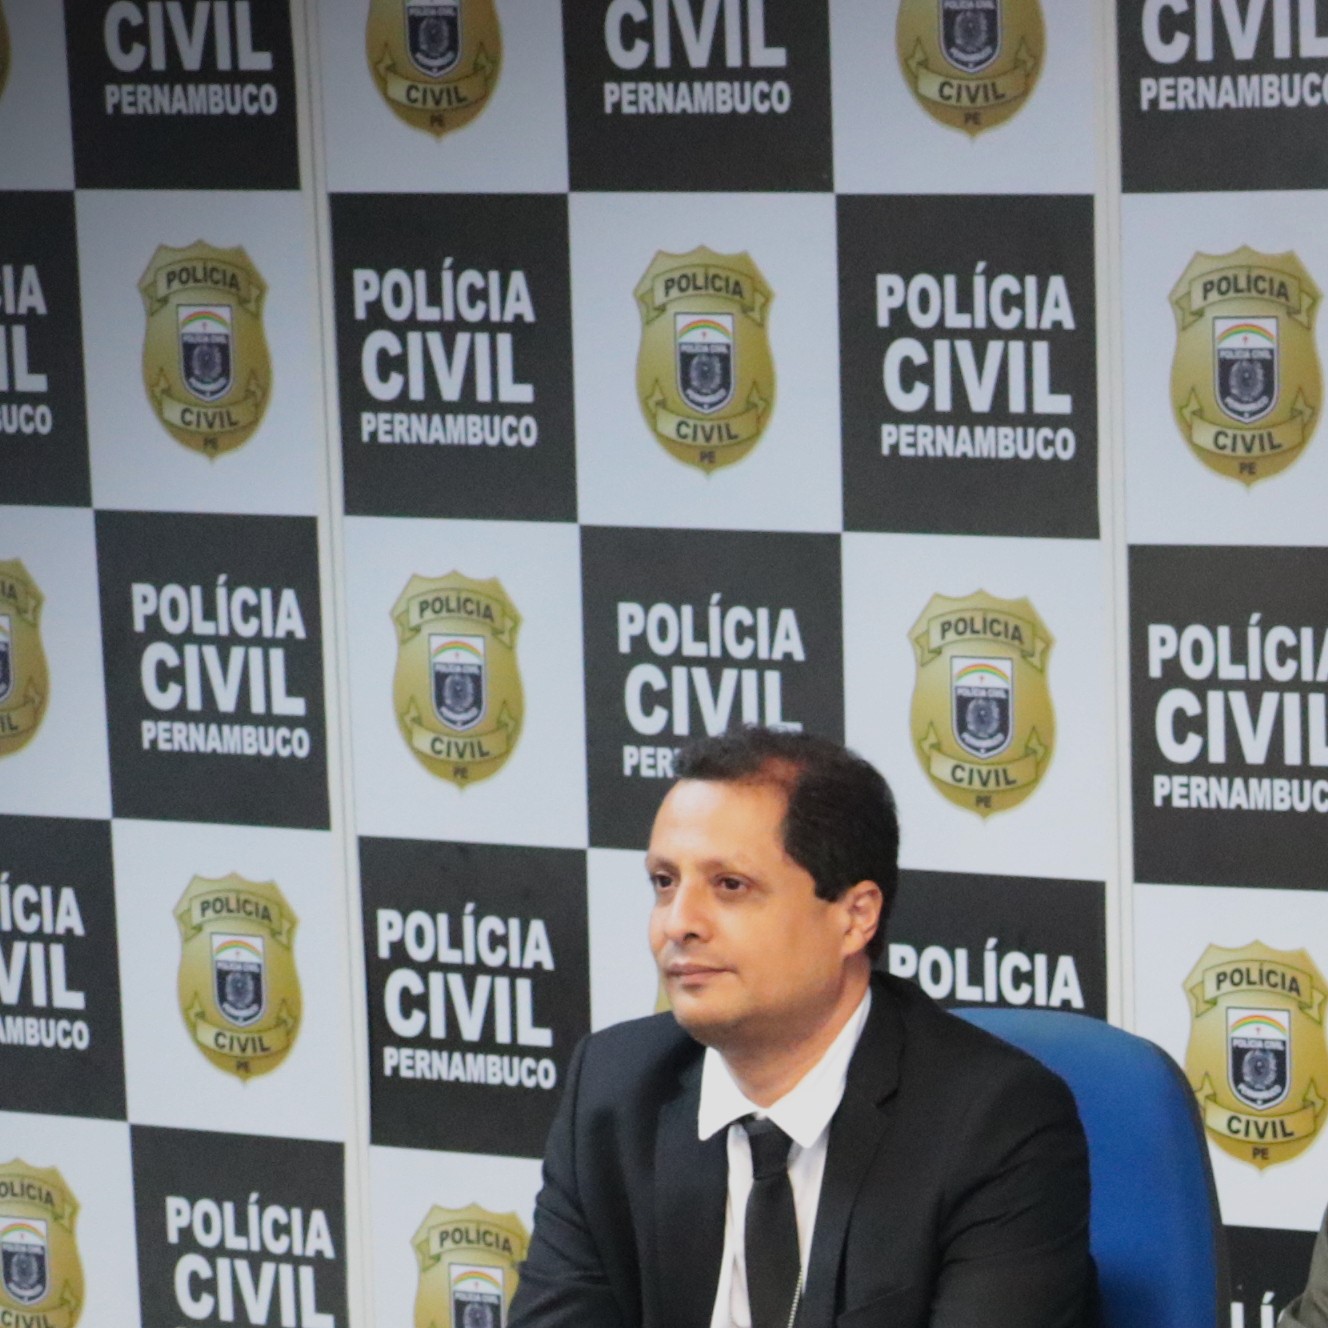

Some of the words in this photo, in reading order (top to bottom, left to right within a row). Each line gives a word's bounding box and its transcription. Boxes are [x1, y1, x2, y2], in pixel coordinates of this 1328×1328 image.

[105, 1, 273, 72] CIVIL
[605, 0, 786, 69] CIVIL
[105, 84, 277, 115] PERNAMBUCO
[406, 83, 468, 104] CIVIL
[604, 81, 791, 113] PERNAMBUCO
[938, 77, 1005, 105] CIVIL
[964, 111, 981, 125] PE
[166, 262, 240, 291] POLÍCIA
[353, 257, 535, 322] POLÍCIA
[664, 272, 744, 299] POLÍCIA
[1202, 273, 1289, 302] POLÍCIA
[876, 262, 1075, 329] POLÍCIA
[362, 330, 534, 403] CIVIL
[883, 338, 1072, 414] CIVIL
[180, 405, 239, 430] CIVIL
[361, 412, 537, 447] PERNAMBUCO
[675, 418, 738, 444] CIVIL
[882, 424, 1075, 460] PERNAMBUCO
[1210, 430, 1282, 454] CIVIL
[132, 574, 306, 639] POLÍCIA
[419, 595, 494, 622] POLÍCIA
[618, 593, 804, 661] POLÍCIA
[940, 616, 1024, 645] POLÍCIA
[141, 642, 305, 716] CIVIL
[624, 664, 804, 735] CIVIL
[142, 721, 310, 758] PERNAMBUCO
[430, 736, 490, 760] CIVIL
[950, 764, 1016, 788] CIVIL
[0, 872, 84, 936] ÍCIA
[200, 897, 272, 923] POLÍCIA
[377, 903, 554, 970] POLÍCIA
[0, 941, 85, 1009] VIL
[889, 938, 1084, 1008] POLÍCIA
[1216, 967, 1301, 997] POLÍCIA
[385, 969, 552, 1047] CIVIL
[214, 1031, 270, 1054] CIVIL
[384, 1047, 556, 1089] PERNAMBUCO
[1227, 1114, 1294, 1139] CIVIL
[0, 1180, 55, 1207] OLÍCIA
[166, 1193, 334, 1259] POLÍCIA
[439, 1227, 513, 1255] POLÍCIA
